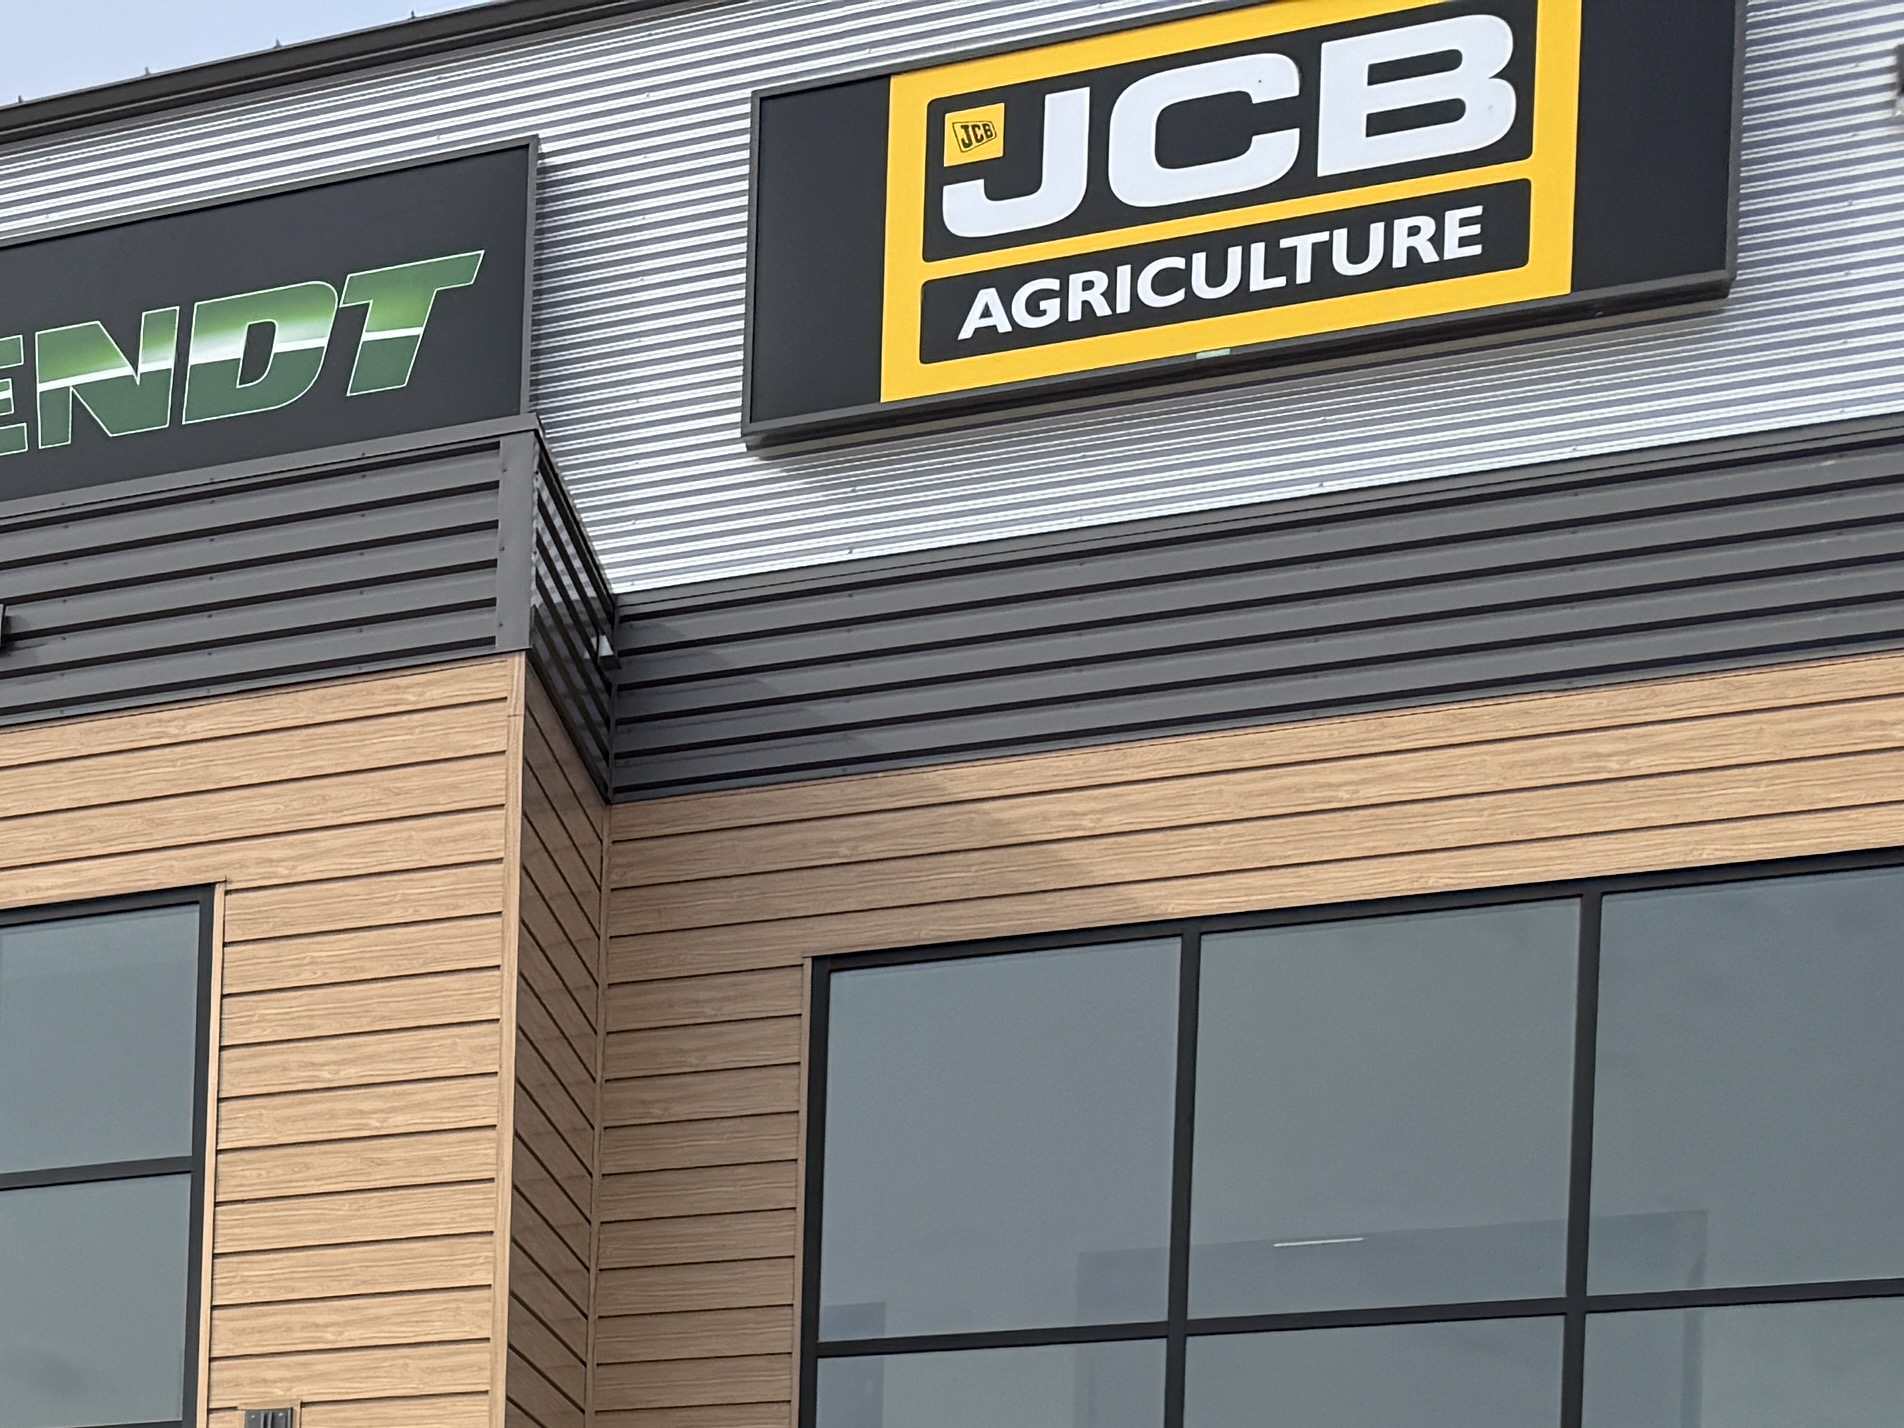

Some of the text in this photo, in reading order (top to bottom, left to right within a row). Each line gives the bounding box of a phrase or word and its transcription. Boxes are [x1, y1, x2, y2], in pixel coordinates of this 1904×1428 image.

[941, 14, 1517, 239] JCB
[960, 123, 993, 149] JCB
[957, 205, 1483, 340] AGRICULTURE
